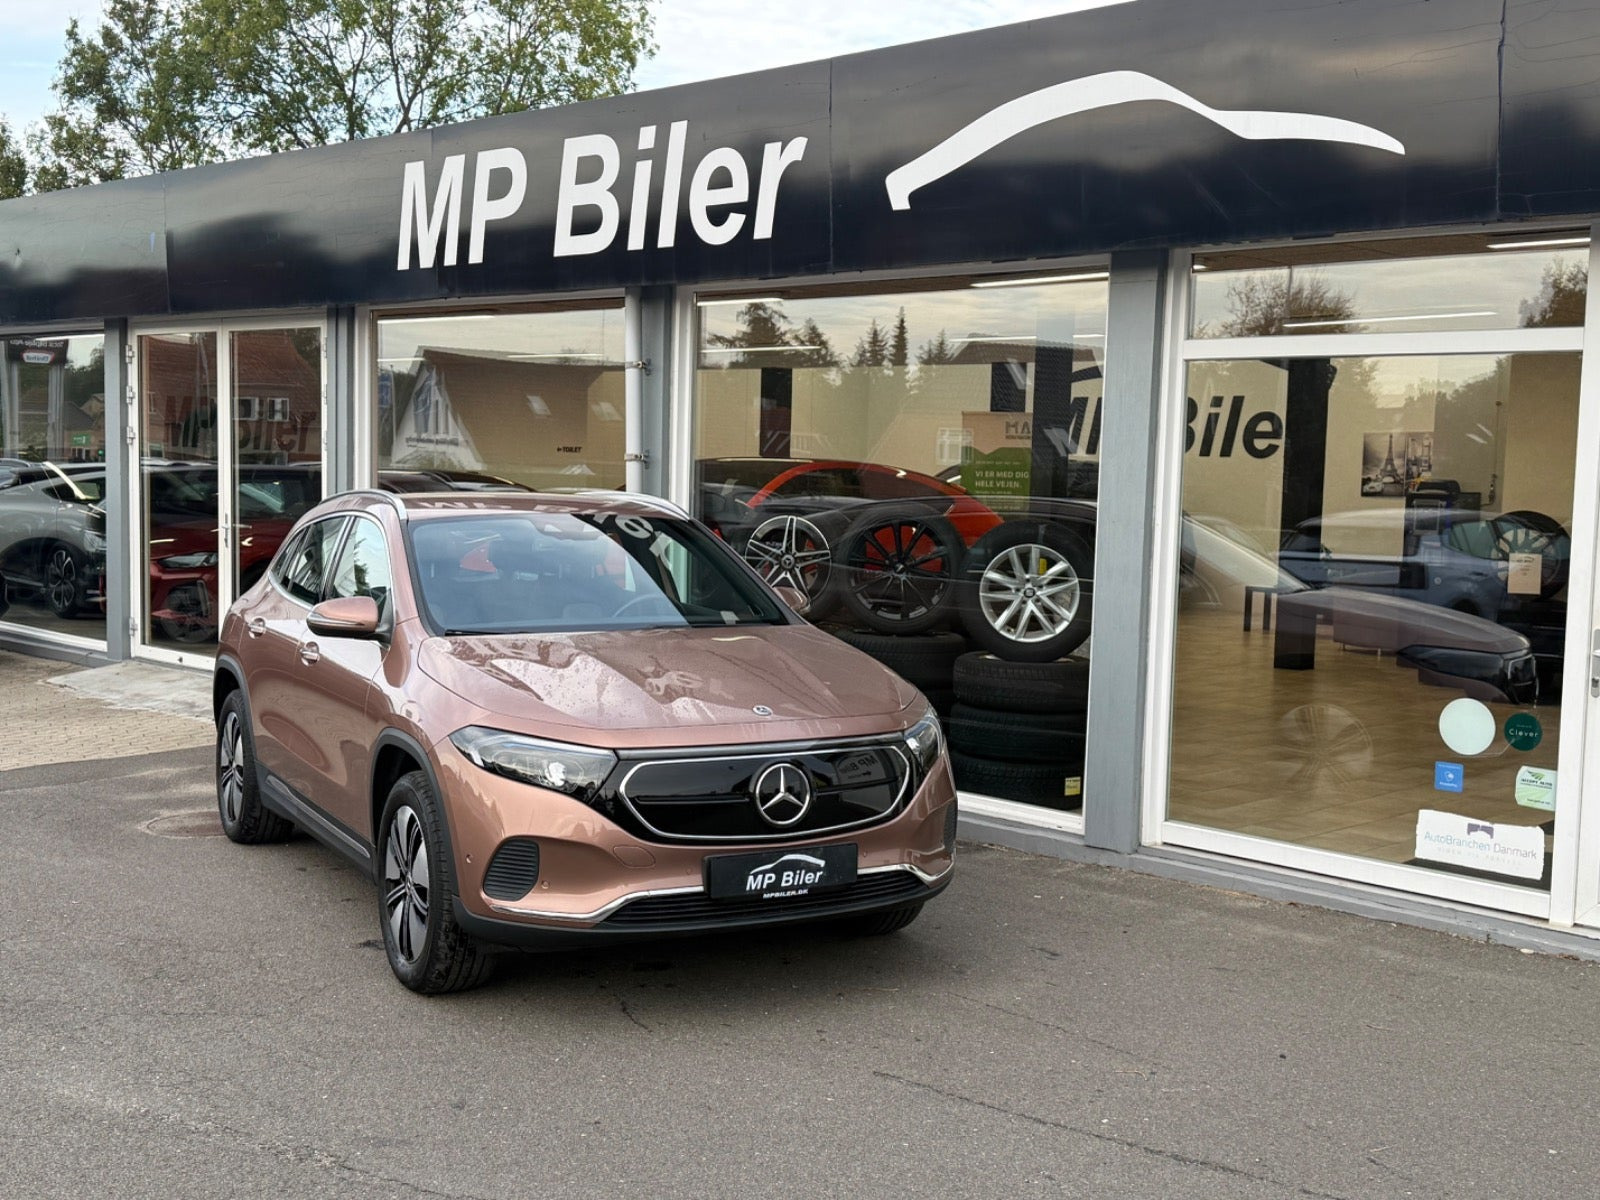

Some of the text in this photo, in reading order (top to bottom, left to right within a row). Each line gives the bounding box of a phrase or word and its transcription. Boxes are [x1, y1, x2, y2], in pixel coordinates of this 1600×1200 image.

[397, 120, 809, 271] MP Biler
[1015, 471, 1029, 479] DIG
[975, 480, 994, 488] HELE
[1508, 728, 1539, 738] Clever
[1424, 831, 1491, 852] AutoBranchen
[1493, 843, 1537, 860] Danmark
[746, 870, 823, 892] MP Biler
[762, 889, 809, 899] MPBILER.DK
